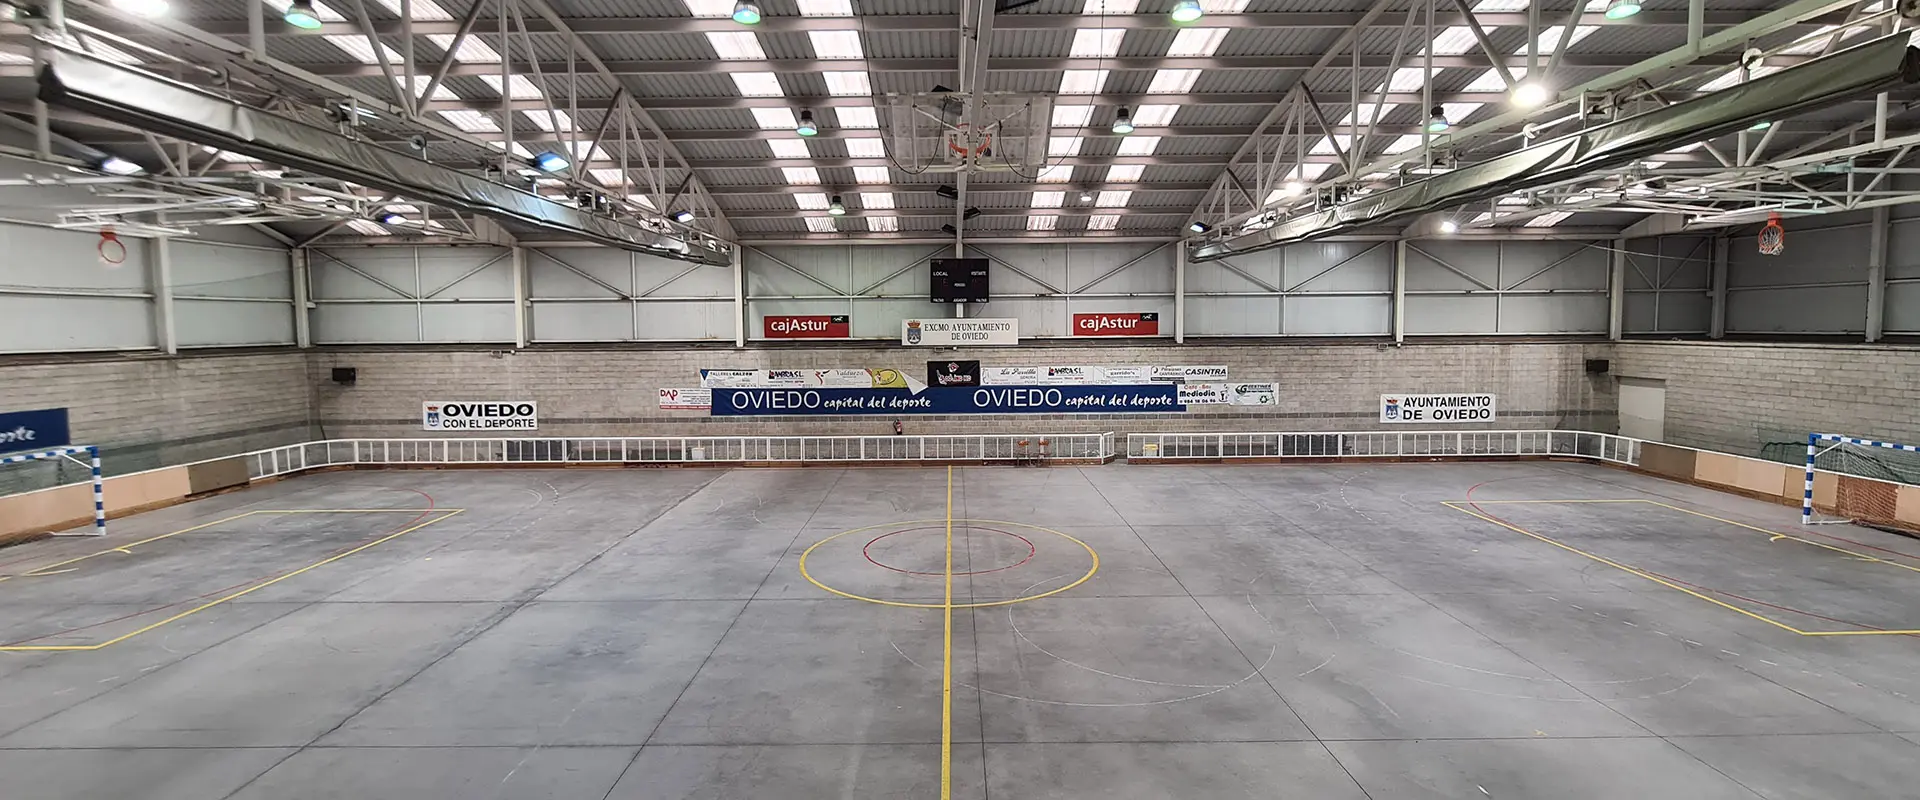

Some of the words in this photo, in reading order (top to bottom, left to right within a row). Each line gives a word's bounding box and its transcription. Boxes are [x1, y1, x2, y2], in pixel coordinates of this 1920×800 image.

[771, 318, 828, 333] cajAstur
[952, 323, 1010, 331] AYUNTAMIENTO
[1080, 315, 1138, 331] cajAstur
[951, 332, 960, 340] DE
[962, 332, 988, 340] OVIEDO
[660, 389, 678, 400] DAP
[973, 389, 1062, 407] OVIEDO
[1065, 394, 1105, 408] capital
[1108, 395, 1127, 406] del
[1130, 394, 1172, 408] deporte
[732, 391, 820, 408] OVIEDO
[824, 396, 864, 410] capital
[867, 397, 886, 408] del
[889, 396, 931, 410] deporte
[1404, 397, 1490, 407] AYUNTAMIENTO
[443, 404, 534, 417] OVIEDO
[1403, 410, 1423, 419] DE
[1433, 409, 1490, 419] OVIEDO
[443, 419, 466, 428] CON
[469, 419, 482, 428] EL
[485, 419, 534, 428] DEPORTE
